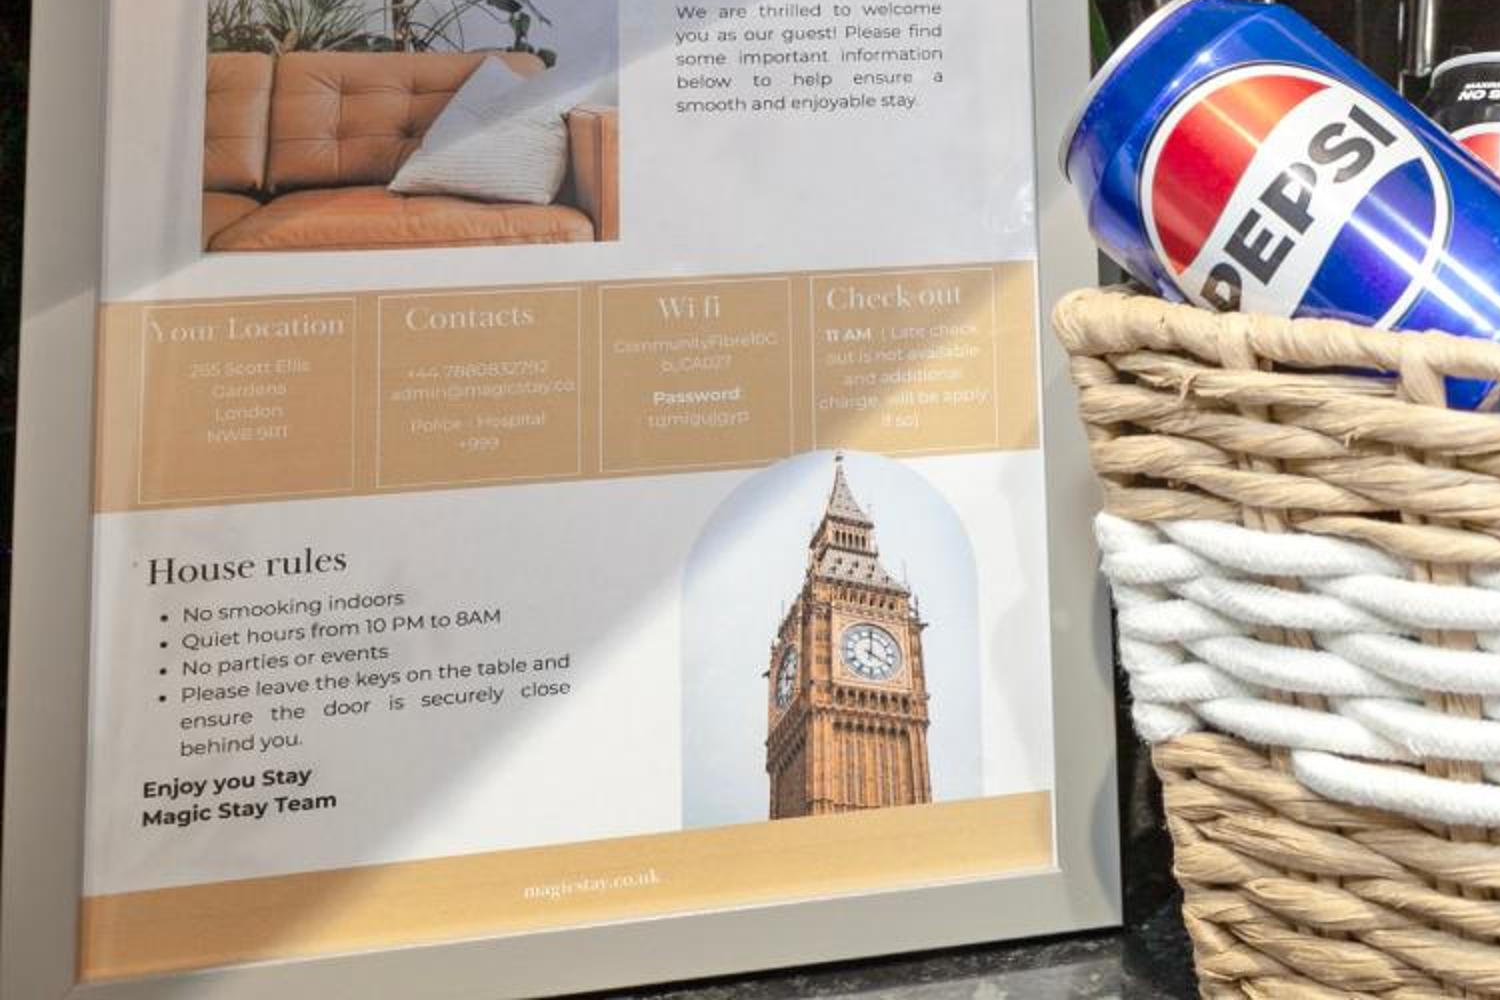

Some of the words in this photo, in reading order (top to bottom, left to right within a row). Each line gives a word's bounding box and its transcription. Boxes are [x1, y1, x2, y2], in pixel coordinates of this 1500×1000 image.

[676, 4, 708, 20] We
[718, 6, 748, 19] are
[759, 3, 821, 18] thrilled
[833, 4, 851, 17] to
[862, 1, 942, 16] welcome
[675, 29, 709, 45] you
[717, 29, 737, 42] as
[743, 28, 775, 42] our
[781, 26, 838, 44] guest!
[845, 24, 902, 40] Please
[908, 22, 943, 39] find
[675, 53, 727, 67] some
[739, 49, 829, 67] important
[841, 46, 943, 63] information
[676, 74, 732, 89] below
[753, 74, 772, 88] to
[792, 70, 833, 89] help
[852, 71, 914, 86] ensure
[932, 72, 944, 83] a
[676, 96, 747, 113] smooth
[751, 96, 785, 111] and
[790, 92, 877, 114] enjoyable
[1457, 89, 1487, 102] NO
[1200, 103, 1399, 313] PEPSI
[826, 283, 911, 310] Check
[917, 286, 961, 307] out
[226, 312, 346, 341] Location
[405, 304, 536, 332] Contacts
[842, 327, 871, 342] AM
[652, 385, 741, 405] Password
[215, 404, 284, 424] London
[148, 556, 256, 586] House
[266, 547, 348, 577] rules
[183, 606, 213, 624] No
[218, 597, 322, 622] smooking
[328, 592, 405, 612] indoors
[181, 630, 240, 651] Quiet
[247, 625, 306, 645] hours
[311, 621, 360, 640] from
[365, 617, 387, 635] 10
[392, 614, 425, 632] PM
[430, 613, 451, 629] to
[455, 608, 502, 628] 8AM
[182, 659, 212, 677] No
[217, 653, 289, 677] parties
[293, 651, 315, 667] or
[320, 644, 390, 665] events
[181, 683, 250, 703] Please
[255, 676, 310, 697] leave
[315, 672, 351, 692] the
[356, 669, 401, 689] keys
[406, 667, 432, 683] on
[438, 662, 472, 680] the
[477, 656, 528, 677] table
[532, 653, 571, 672] and
[180, 709, 254, 731] ensure
[270, 703, 306, 722] the
[322, 698, 372, 717] door
[388, 693, 405, 711] is
[420, 684, 504, 708] securely
[520, 680, 572, 699] close
[180, 734, 255, 758] behind
[259, 732, 304, 753] you.
[142, 776, 208, 801] Enjoy
[213, 774, 256, 795] you
[262, 767, 313, 788] Stay
[142, 804, 212, 828] Magic
[217, 800, 269, 820] Stay
[273, 794, 338, 814] Team
